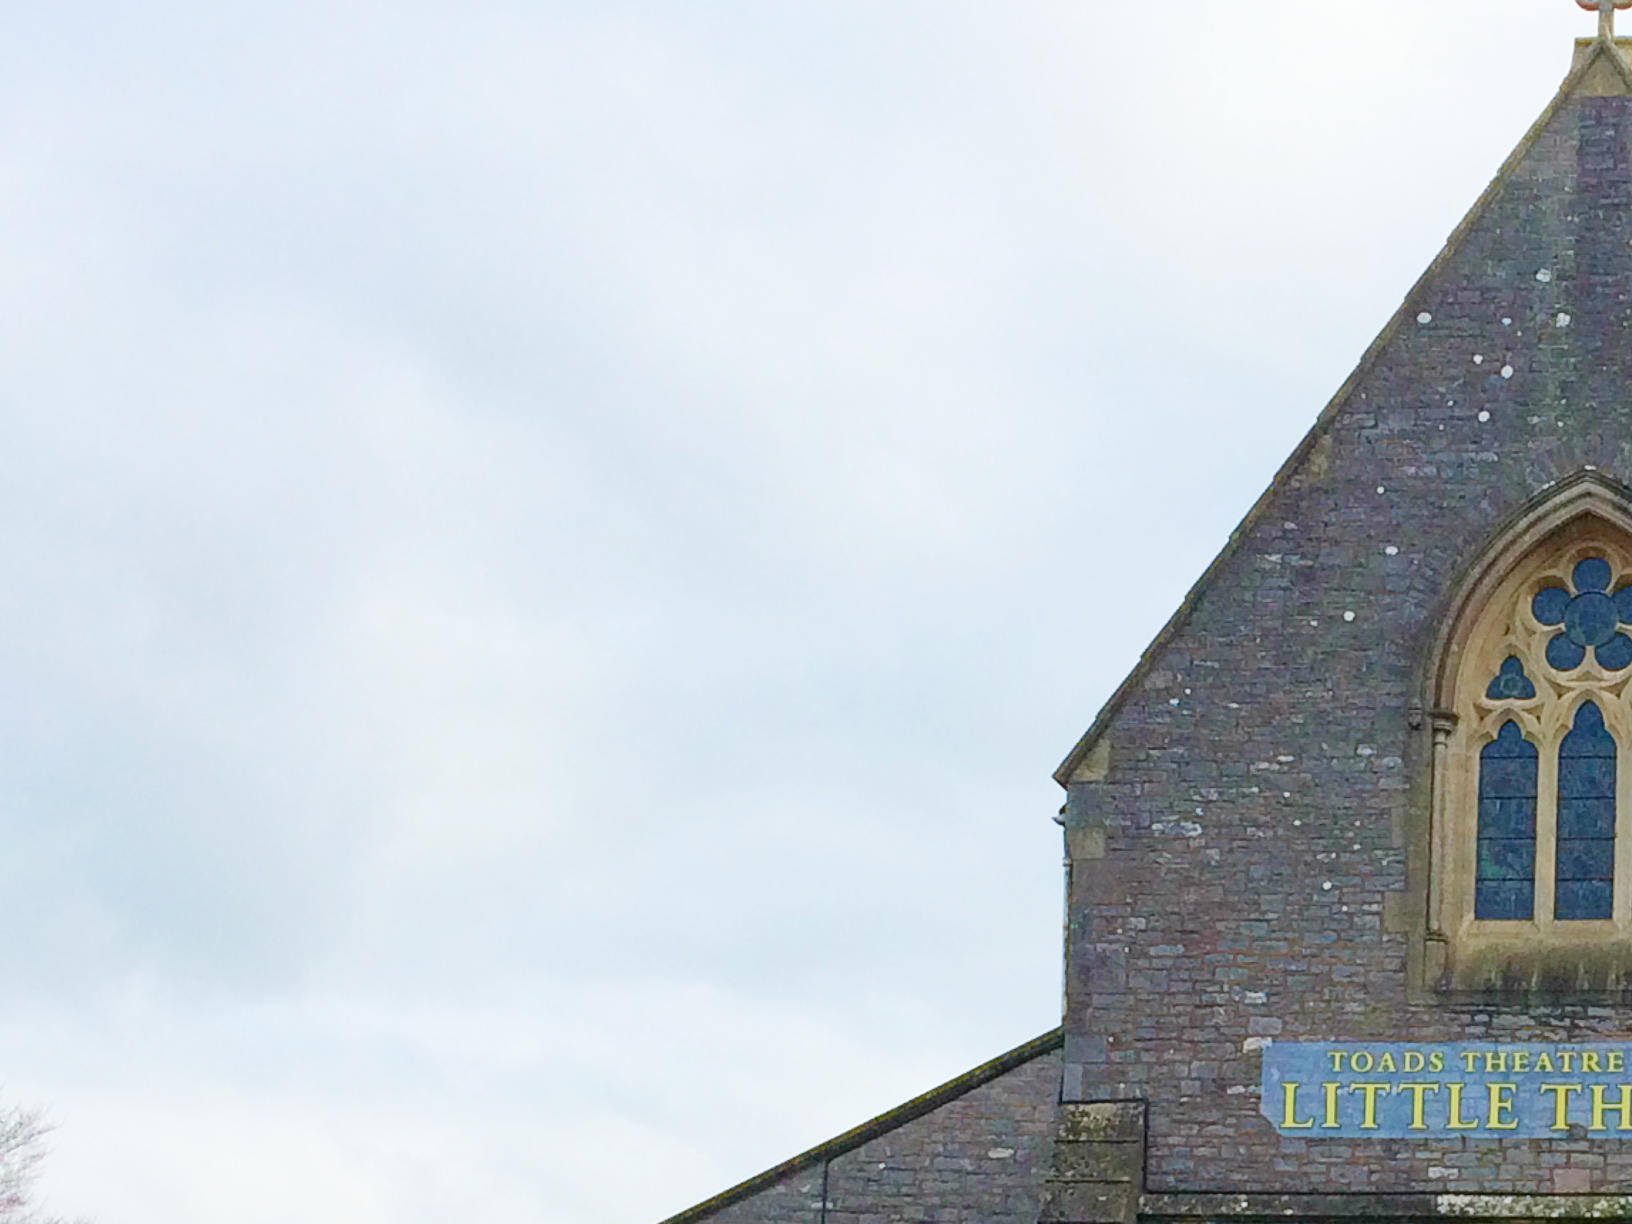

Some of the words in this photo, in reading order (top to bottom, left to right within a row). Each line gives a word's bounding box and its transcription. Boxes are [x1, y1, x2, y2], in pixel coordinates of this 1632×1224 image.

[1328, 1050, 1445, 1073] TOADS
[1460, 1051, 1625, 1073] THEATRE
[1279, 1081, 1520, 1130] LITTLE
